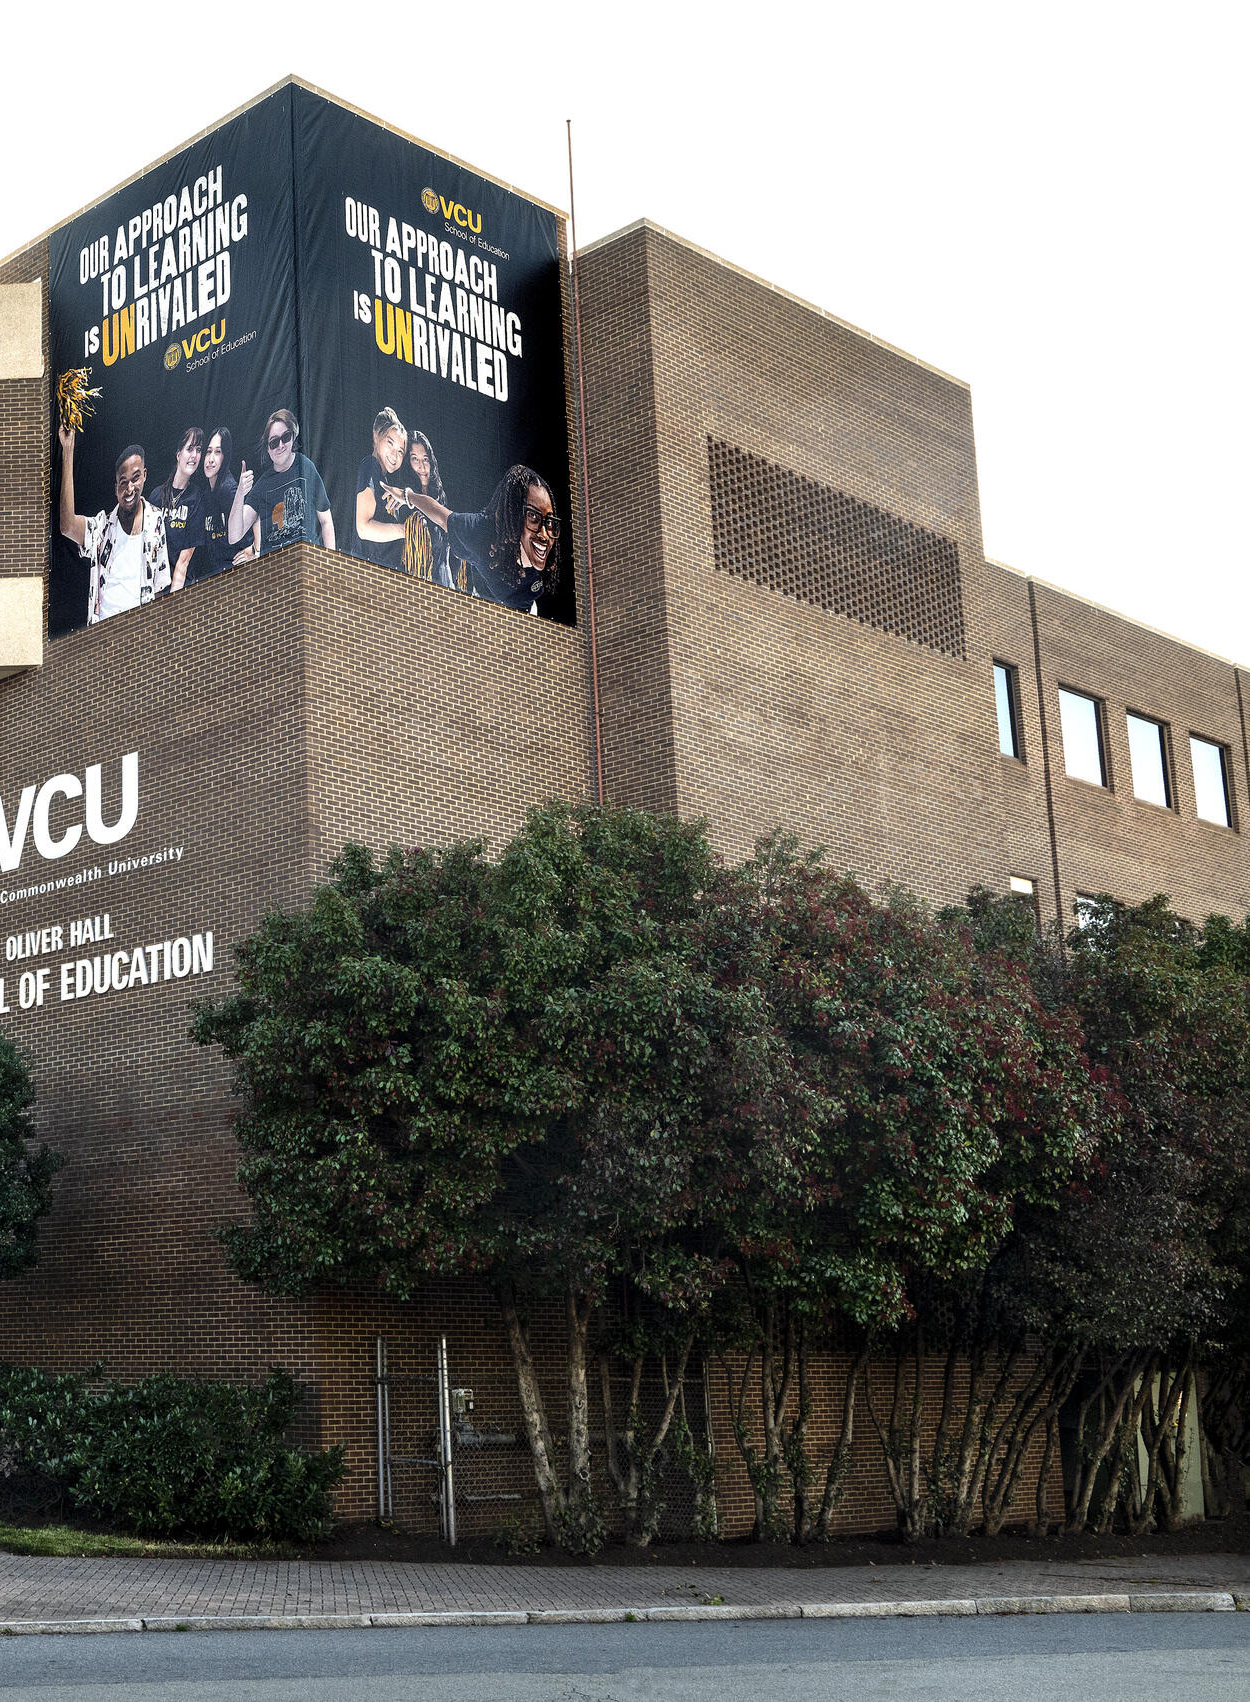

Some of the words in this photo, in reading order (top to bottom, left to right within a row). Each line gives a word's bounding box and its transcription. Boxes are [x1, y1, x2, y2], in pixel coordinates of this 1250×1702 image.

[79, 235, 110, 285] OUR
[113, 164, 223, 266] APPROACH
[345, 196, 381, 250] OUR
[385, 216, 498, 303] APPROACH
[439, 194, 482, 234] VCU
[444, 221, 468, 241] School
[468, 235, 477, 245] of
[477, 237, 510, 261] Education
[100, 264, 127, 317] TO
[133, 193, 248, 300] LEARNING
[84, 325, 100, 358] IS
[102, 250, 231, 367] UNRIVALED
[181, 318, 226, 360] VCU
[371, 248, 402, 304] TO
[409, 266, 523, 358] LEARNING
[186, 352, 210, 373] School
[211, 346, 220, 360] of
[221, 330, 257, 355] Education
[353, 289, 372, 324] IS
[374, 298, 509, 402] UNRIVALED
[0, 866, 102, 905] Commonwealth
[107, 846, 184, 876] University
[5, 925, 64, 961] OLIVER
[69, 913, 115, 947] HALL
[18, 968, 51, 1010] OF
[60, 931, 214, 1001] EDUCATION
